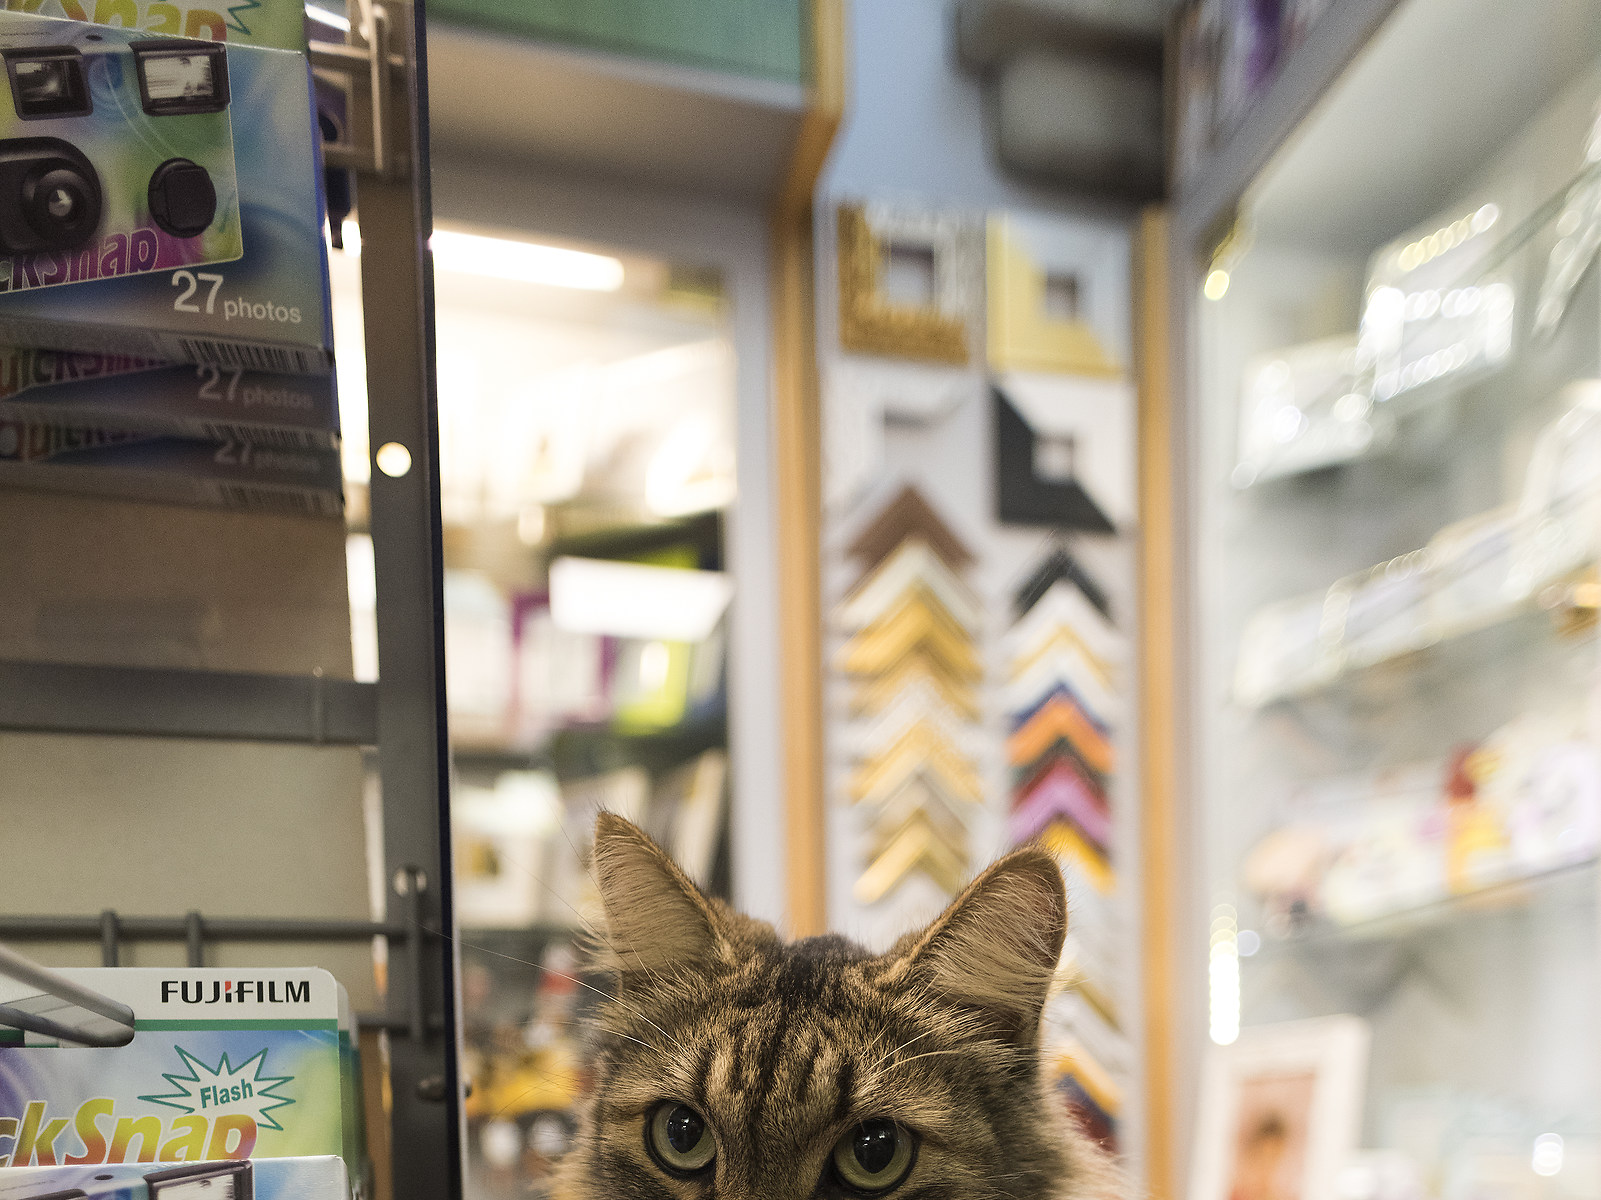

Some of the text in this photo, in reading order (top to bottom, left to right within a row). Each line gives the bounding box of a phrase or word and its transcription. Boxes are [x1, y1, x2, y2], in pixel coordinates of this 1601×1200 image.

[172, 270, 302, 324] 27 photos
[197, 362, 243, 402] 27
[161, 981, 310, 1004] FUJIFILM
[200, 1079, 254, 1109] Flash
